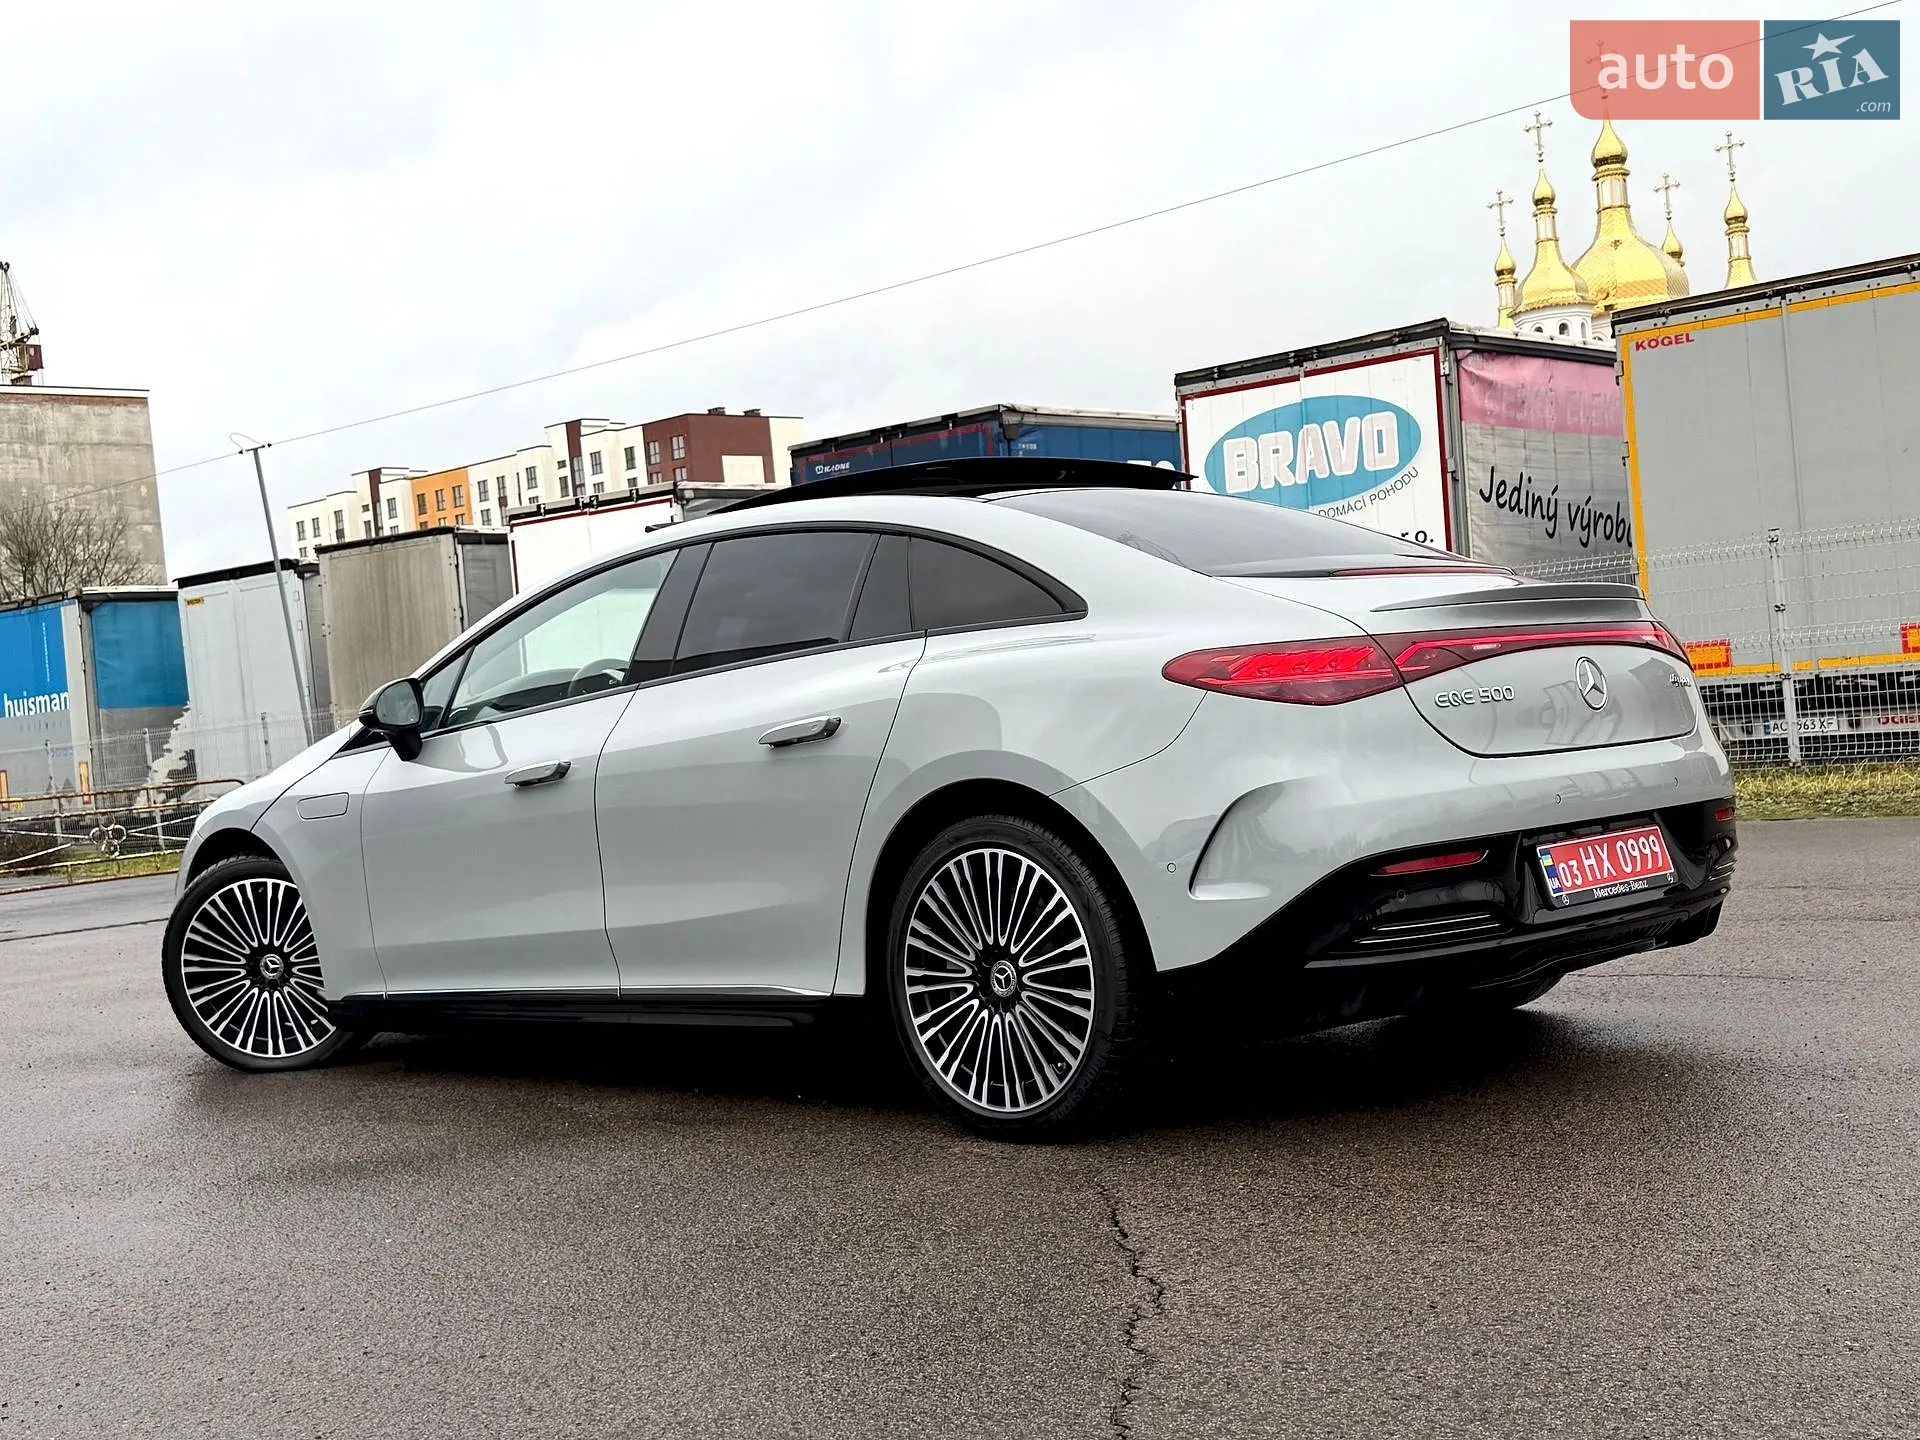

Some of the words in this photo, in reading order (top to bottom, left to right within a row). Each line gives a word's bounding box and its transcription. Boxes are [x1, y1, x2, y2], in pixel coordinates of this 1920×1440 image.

[1222, 411, 1400, 494] BRAVO
[1369, 467, 1419, 505] POHODU
[1479, 465, 1559, 539] Jediný
[3, 690, 70, 718] huisman
[1435, 689, 1476, 708] EQE
[1478, 685, 1515, 704] 500
[1558, 859, 1583, 888] 03
[1578, 842, 1617, 882] HX
[1615, 834, 1663, 874] 0999
[1592, 879, 1649, 899] Mercedes-Benz
